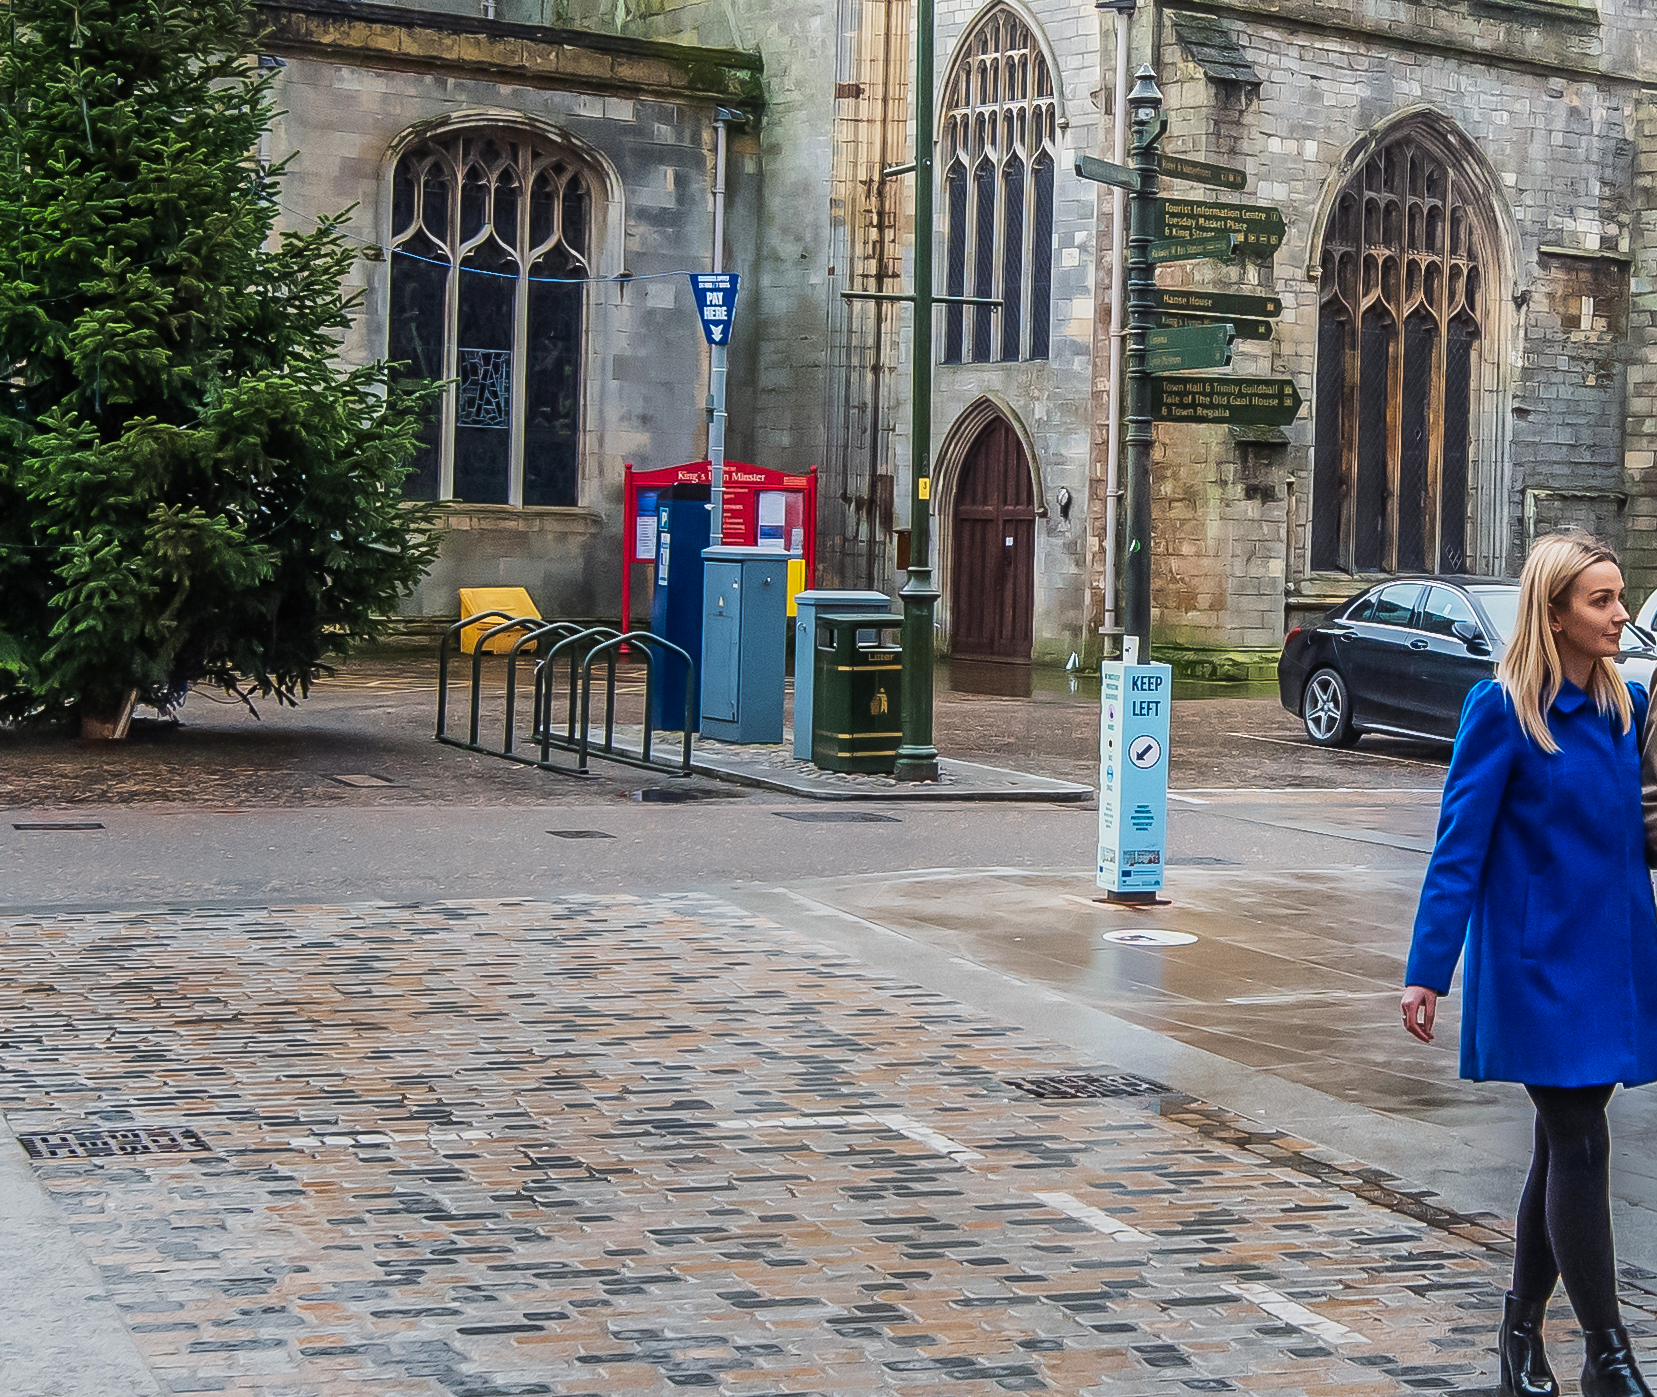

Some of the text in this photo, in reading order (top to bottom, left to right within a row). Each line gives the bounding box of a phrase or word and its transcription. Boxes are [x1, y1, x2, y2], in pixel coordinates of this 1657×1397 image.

[1165, 203, 1267, 220] Tourist Information Centre
[1165, 215, 1196, 227] Tuesday
[1227, 219, 1248, 230] Place
[1164, 227, 1170, 236] &
[1172, 227, 1190, 239] King
[706, 292, 723, 305] PAY
[1163, 294, 1213, 307] Hanse House
[704, 306, 728, 320] HERE
[1163, 382, 1279, 394] Town Hall & Trinity Guildhall
[1163, 394, 1279, 406] Tale of The Old Gaol House
[1161, 407, 1230, 418] & Town Regalia
[678, 470, 706, 483] King's
[731, 472, 766, 482] Minster
[868, 653, 895, 662] Litter
[1131, 676, 1163, 692] KEEP
[1132, 700, 1161, 717] LEFT
